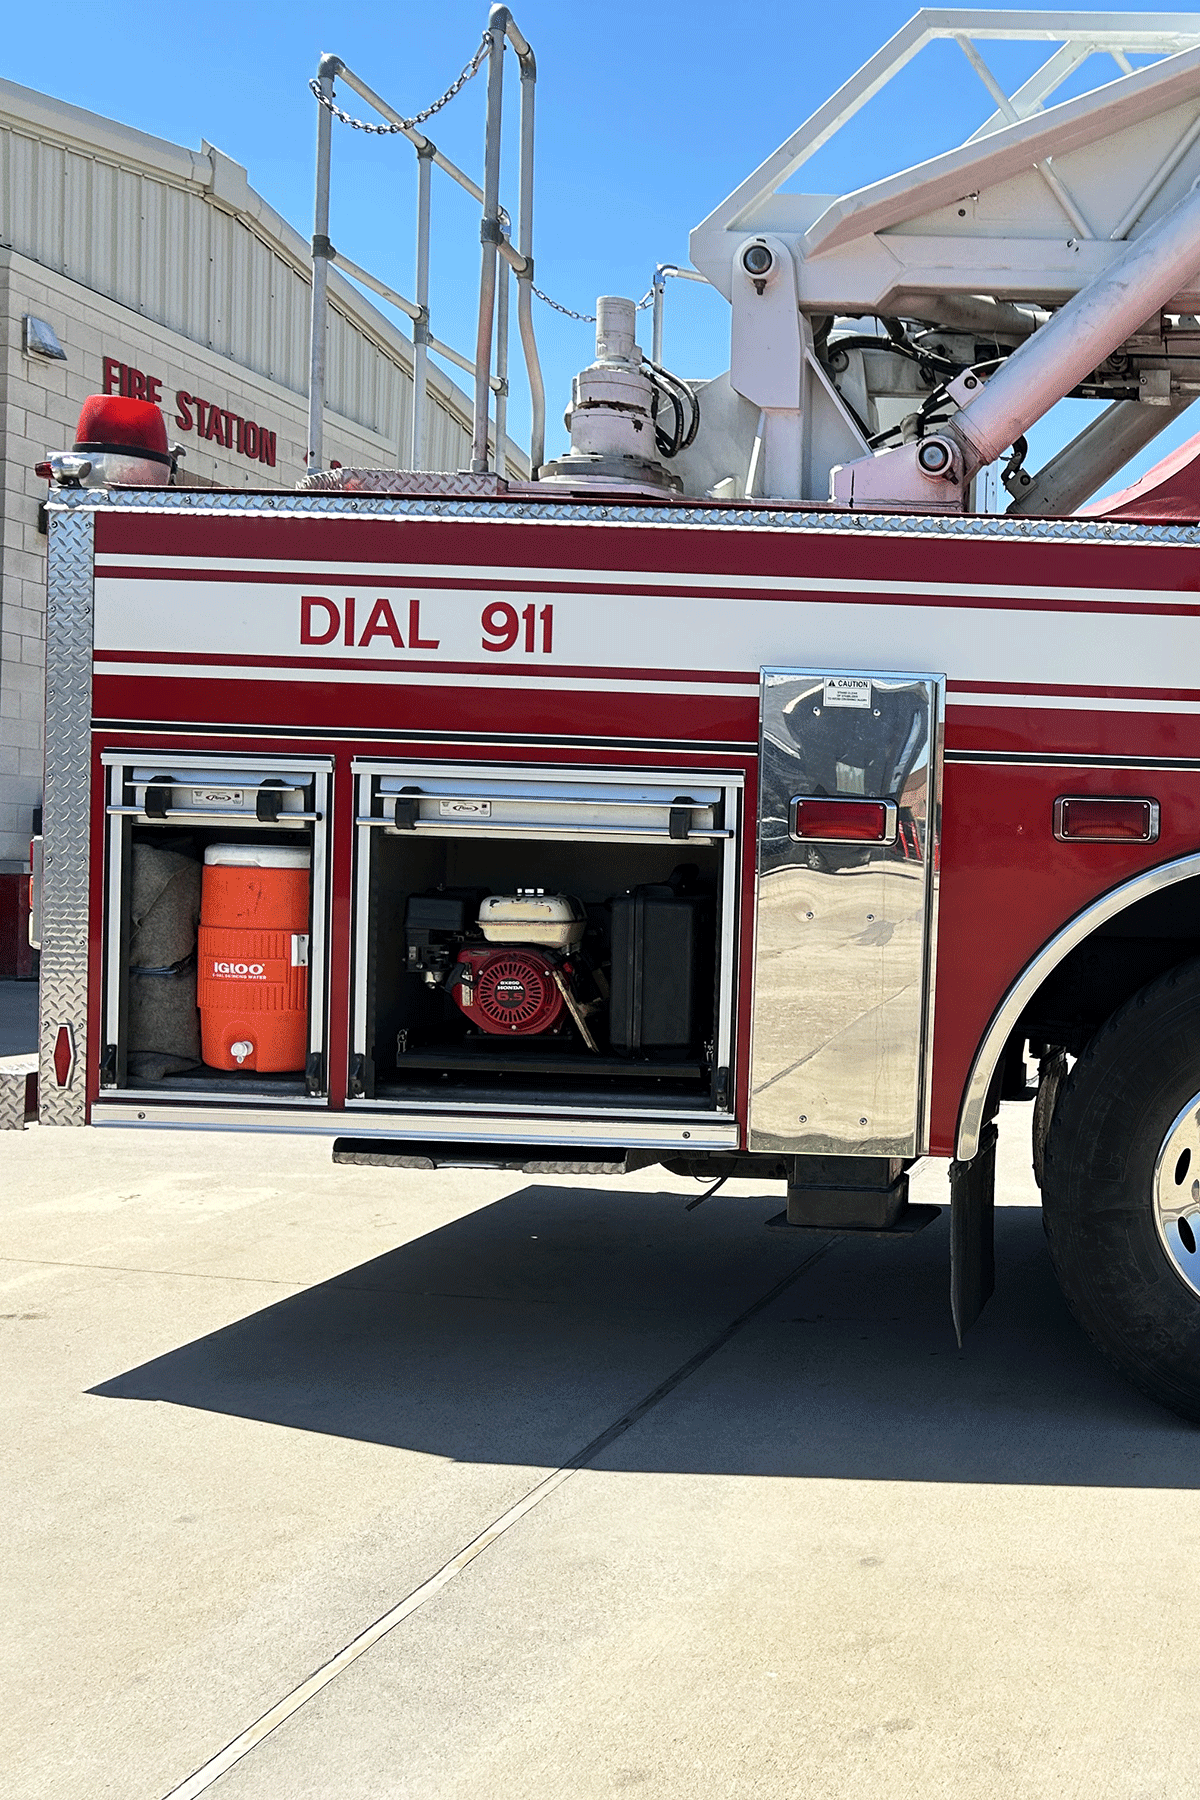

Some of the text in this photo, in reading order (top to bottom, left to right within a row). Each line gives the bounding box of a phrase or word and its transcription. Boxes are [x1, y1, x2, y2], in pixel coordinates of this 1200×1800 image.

[103, 356, 276, 468] FIRE STATION
[301, 595, 554, 653] DIAL 911
[214, 962, 263, 974] IGLOO
[497, 991, 523, 1001] 6.5
